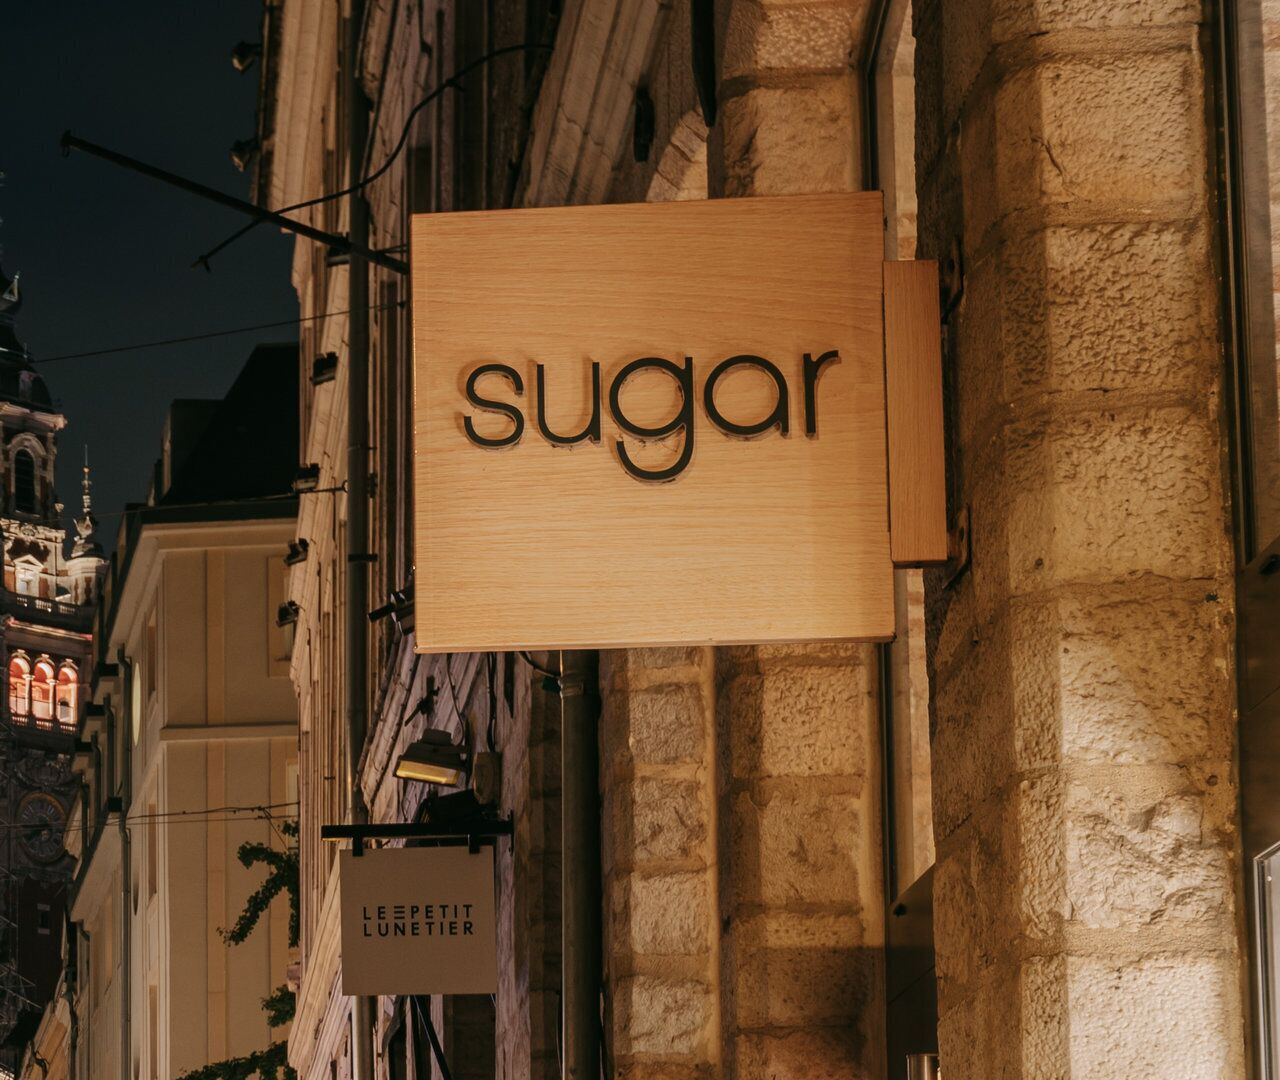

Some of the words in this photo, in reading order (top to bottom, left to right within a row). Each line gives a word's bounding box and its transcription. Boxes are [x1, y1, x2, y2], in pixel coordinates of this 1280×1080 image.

[463, 349, 839, 483] sugar
[410, 904, 473, 920] PETIT
[363, 921, 474, 937] LUNETIER
